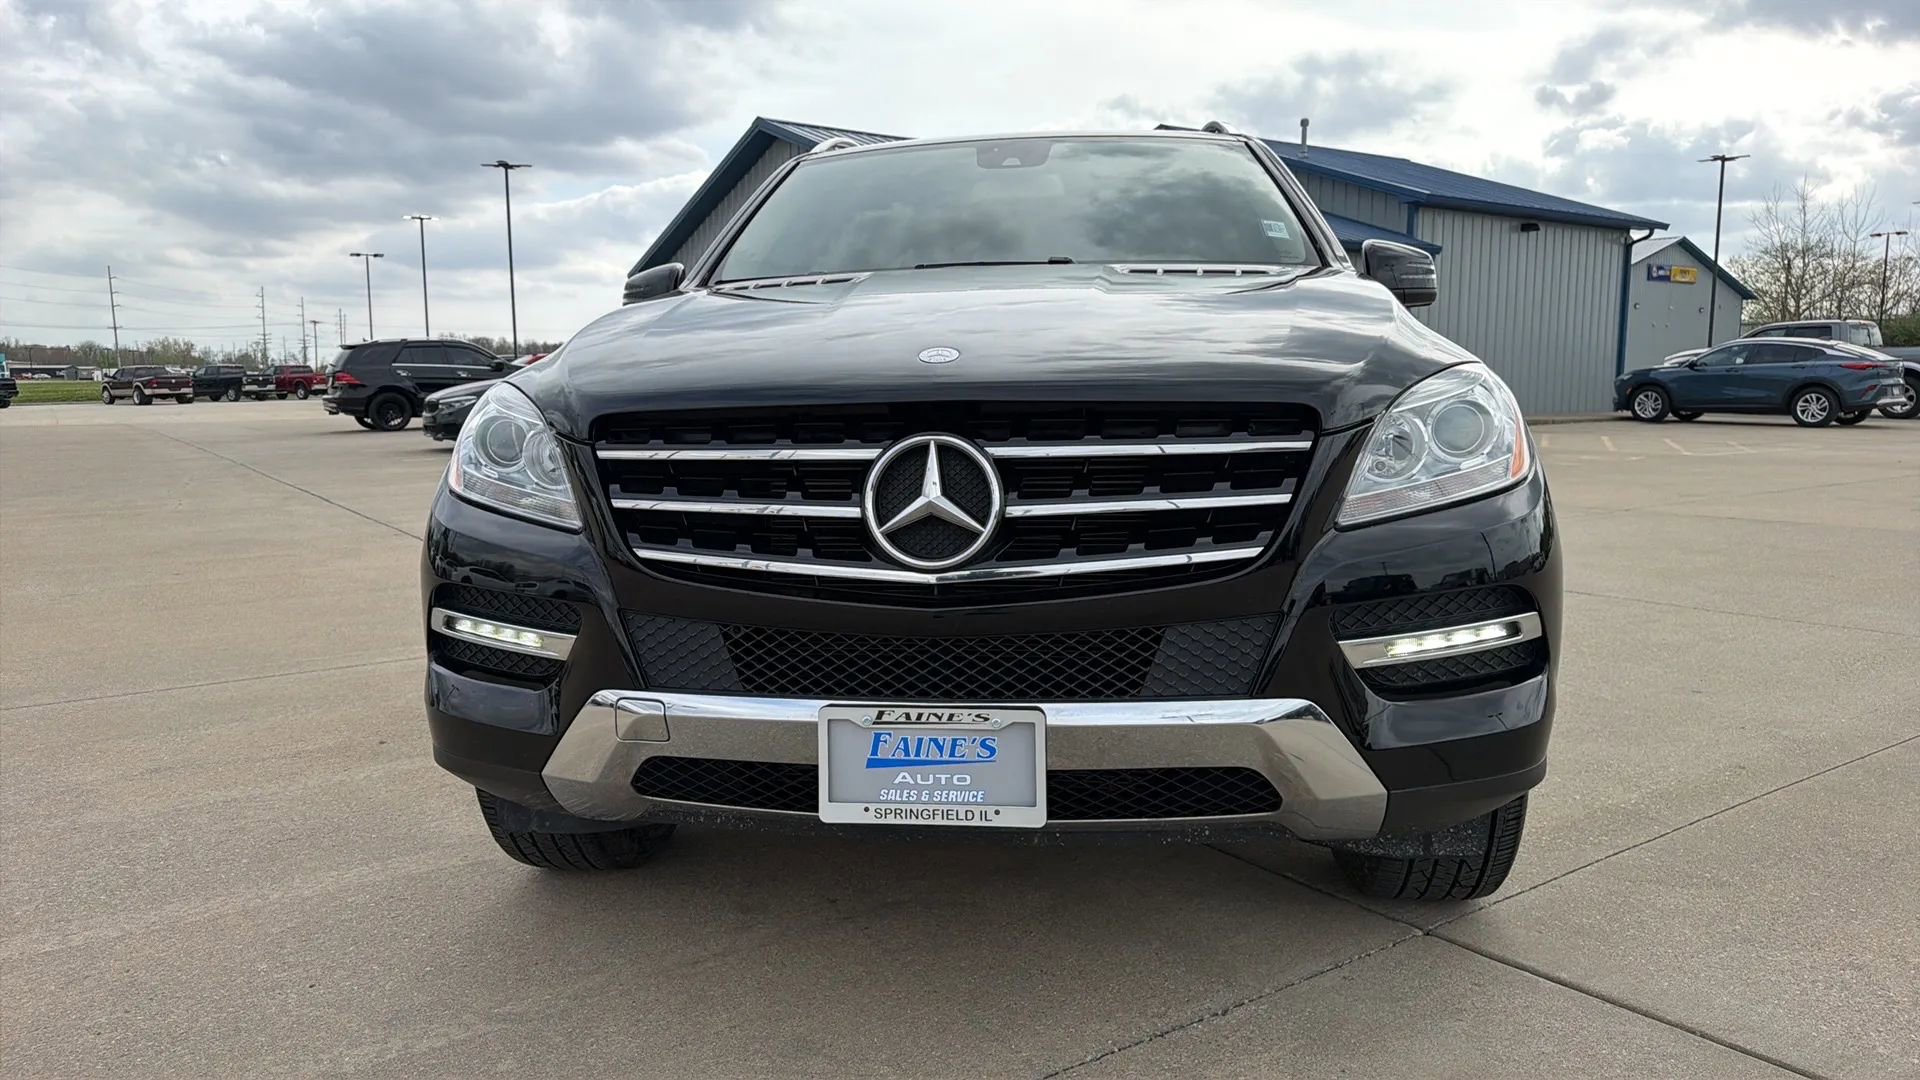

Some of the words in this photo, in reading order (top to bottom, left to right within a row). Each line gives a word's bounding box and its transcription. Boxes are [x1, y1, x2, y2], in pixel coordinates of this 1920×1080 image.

[874, 710, 990, 722] FAINE'S
[869, 731, 998, 759] FAINE'S
[893, 772, 971, 785] AUTO
[879, 789, 918, 801] SALES
[921, 790, 930, 801] &
[933, 790, 985, 802] SERVICE
[874, 808, 975, 821] SPRINGFIELD
[980, 809, 993, 821] IL
